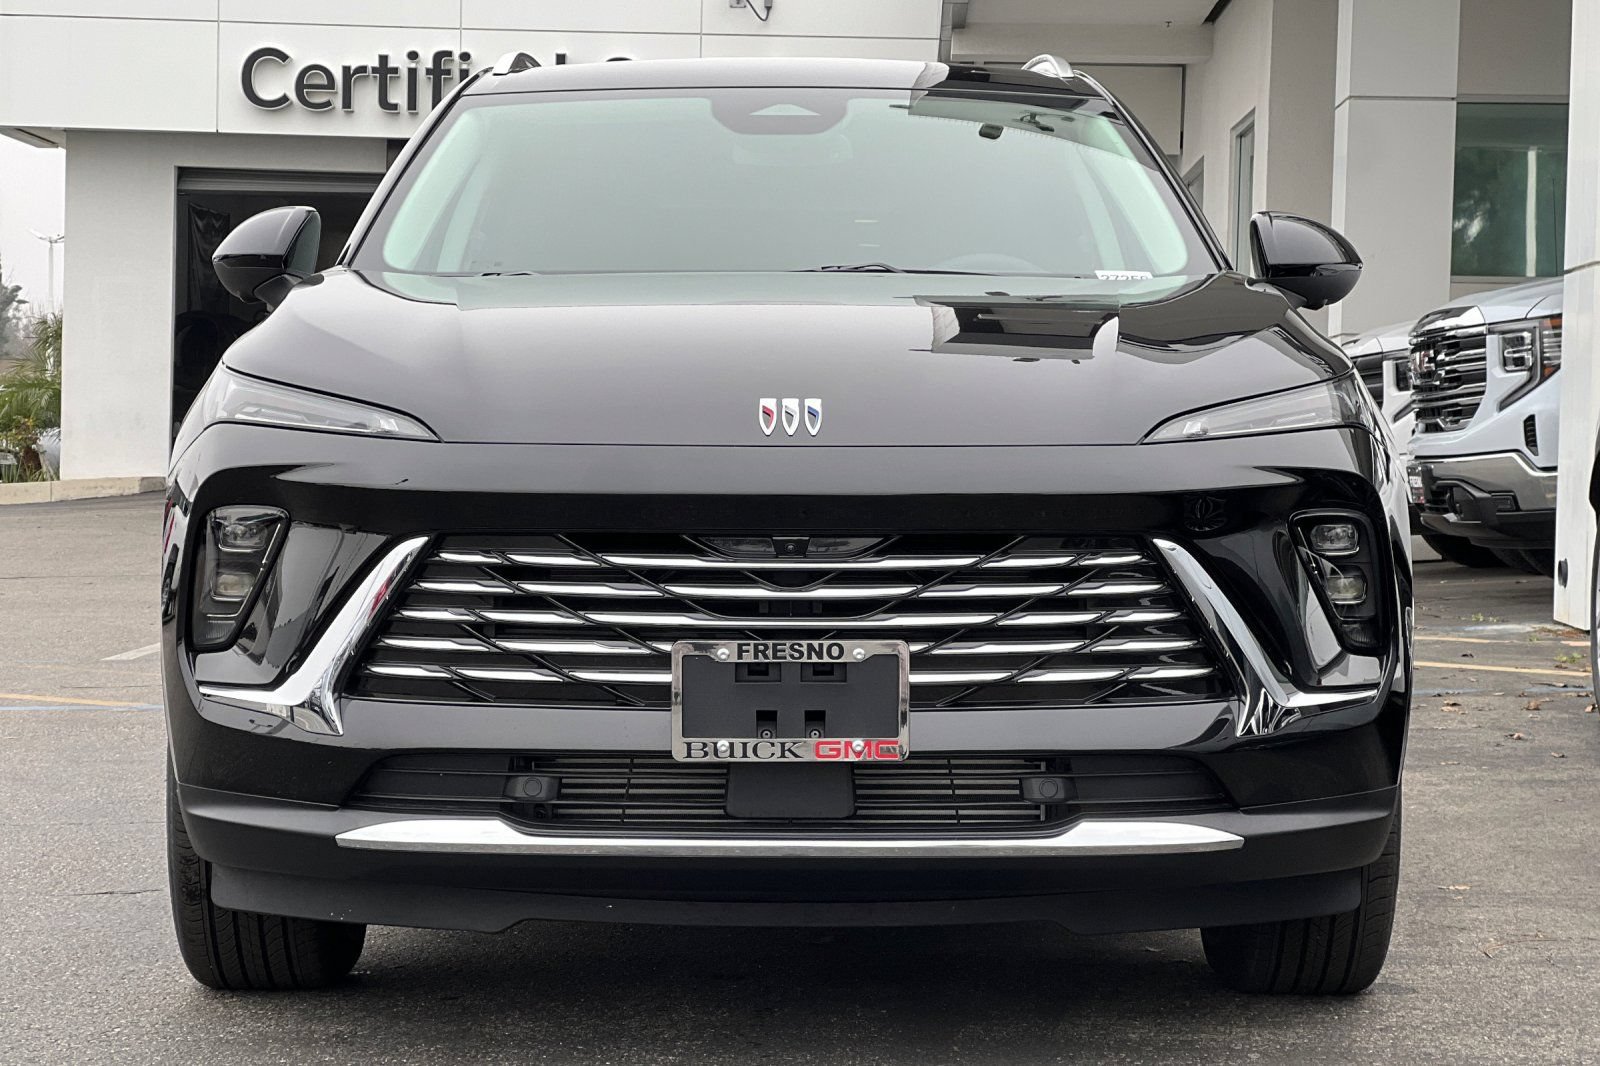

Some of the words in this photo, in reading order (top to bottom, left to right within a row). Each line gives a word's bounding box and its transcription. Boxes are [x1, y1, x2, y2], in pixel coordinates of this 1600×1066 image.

[241, 47, 567, 113] Certifi
[736, 642, 845, 660] FRESNO
[683, 741, 805, 759] BUICK
[814, 740, 899, 759] GMC
